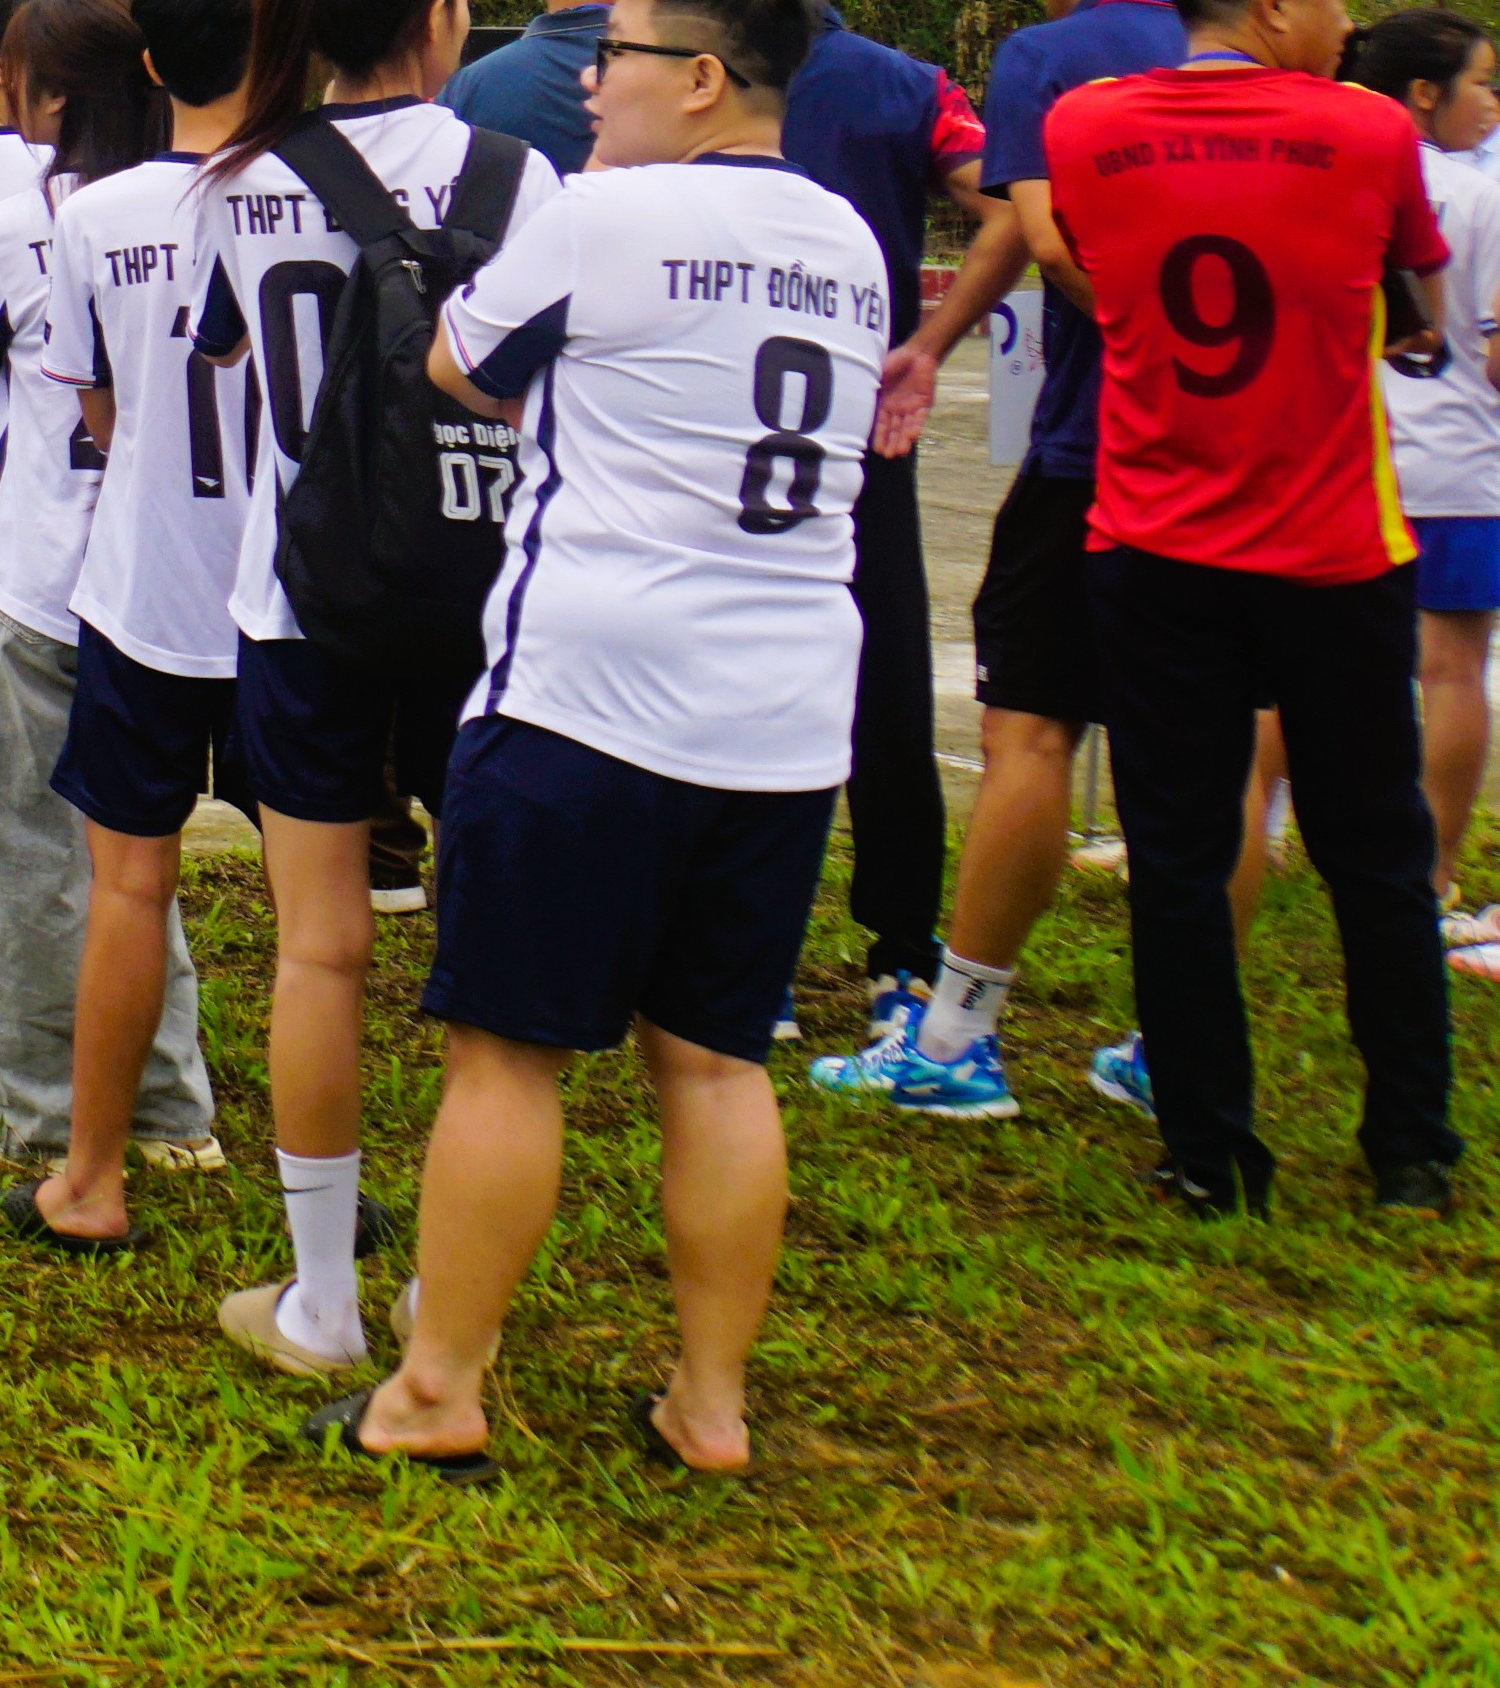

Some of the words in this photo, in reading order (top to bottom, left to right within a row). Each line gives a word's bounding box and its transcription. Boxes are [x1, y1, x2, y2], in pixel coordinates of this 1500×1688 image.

[227, 194, 306, 235] THPT
[104, 242, 179, 288] THPT
[661, 259, 755, 304] THPT
[766, 258, 839, 319] ĐỒNG
[1157, 233, 1277, 399] 9
[736, 335, 835, 535] 8
[439, 451, 515, 524] 07
